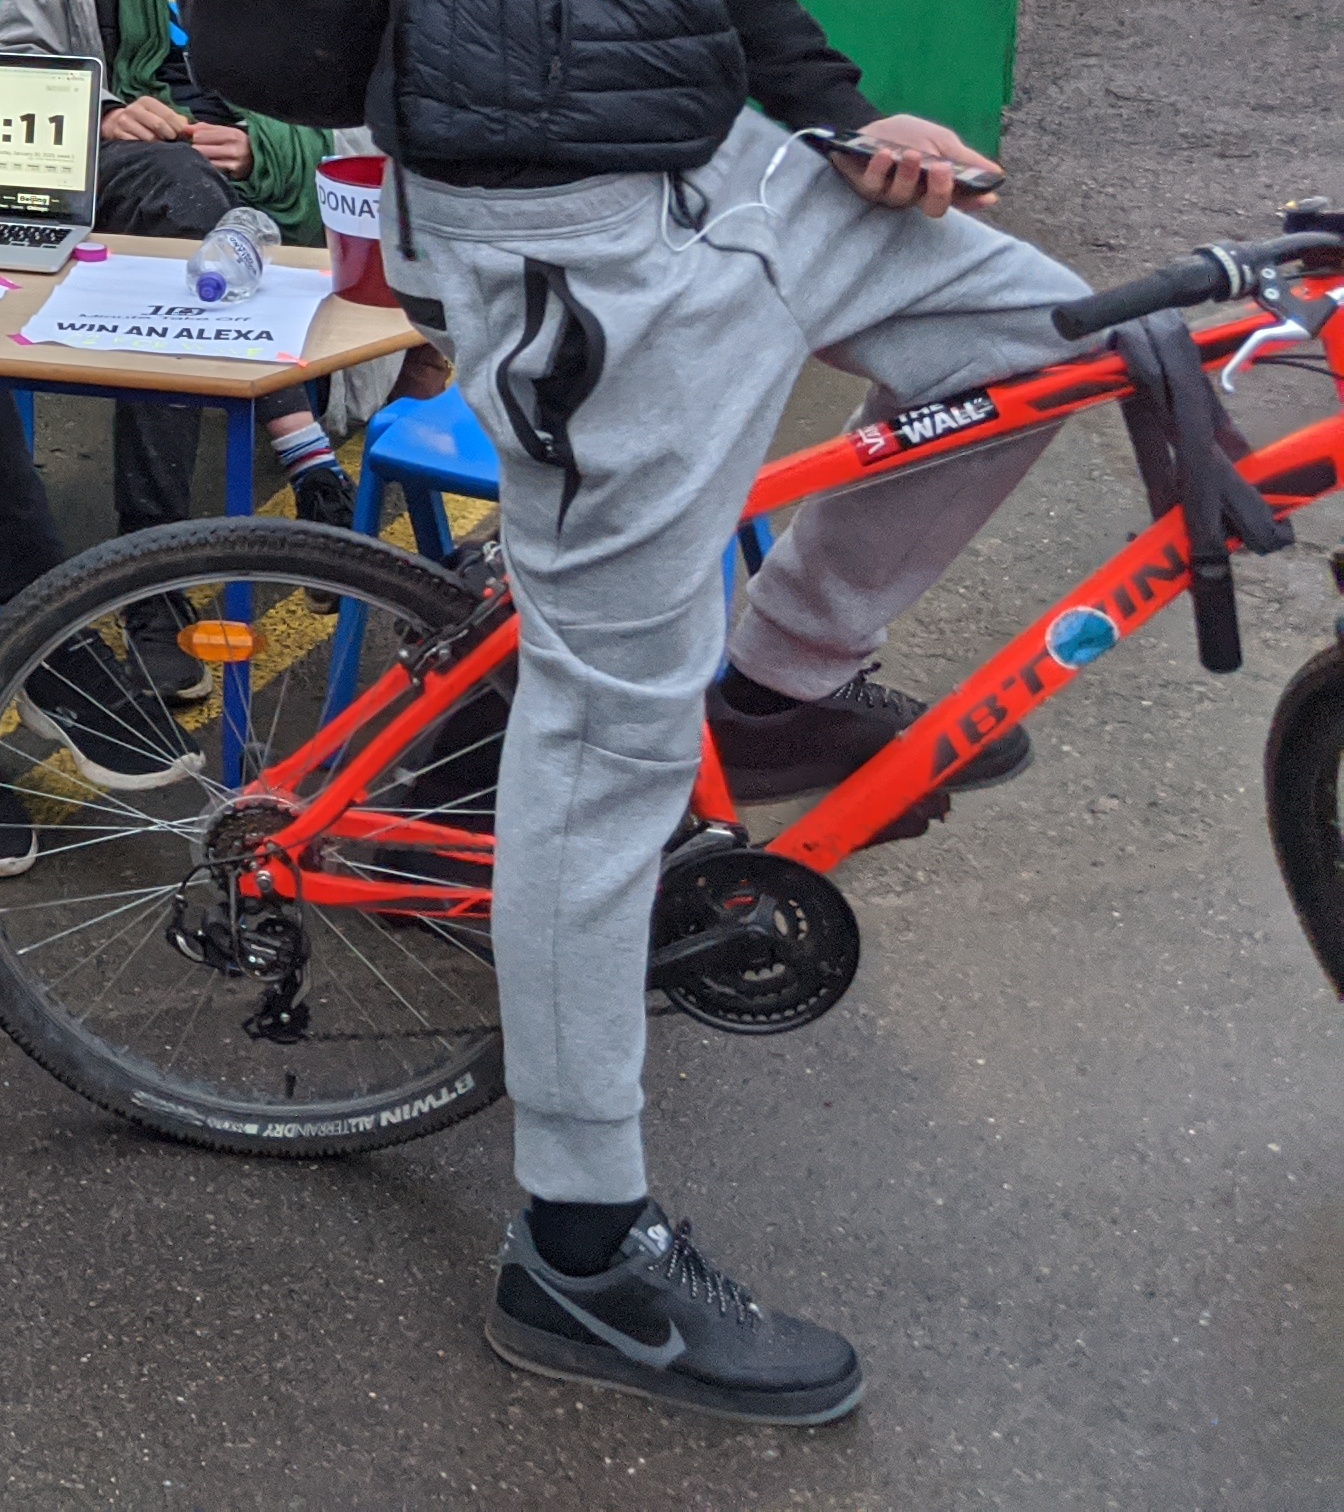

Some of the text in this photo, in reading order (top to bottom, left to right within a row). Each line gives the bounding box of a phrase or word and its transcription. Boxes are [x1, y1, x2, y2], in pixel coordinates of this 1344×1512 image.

[56, 322, 275, 342] WIN AN ALEXA
